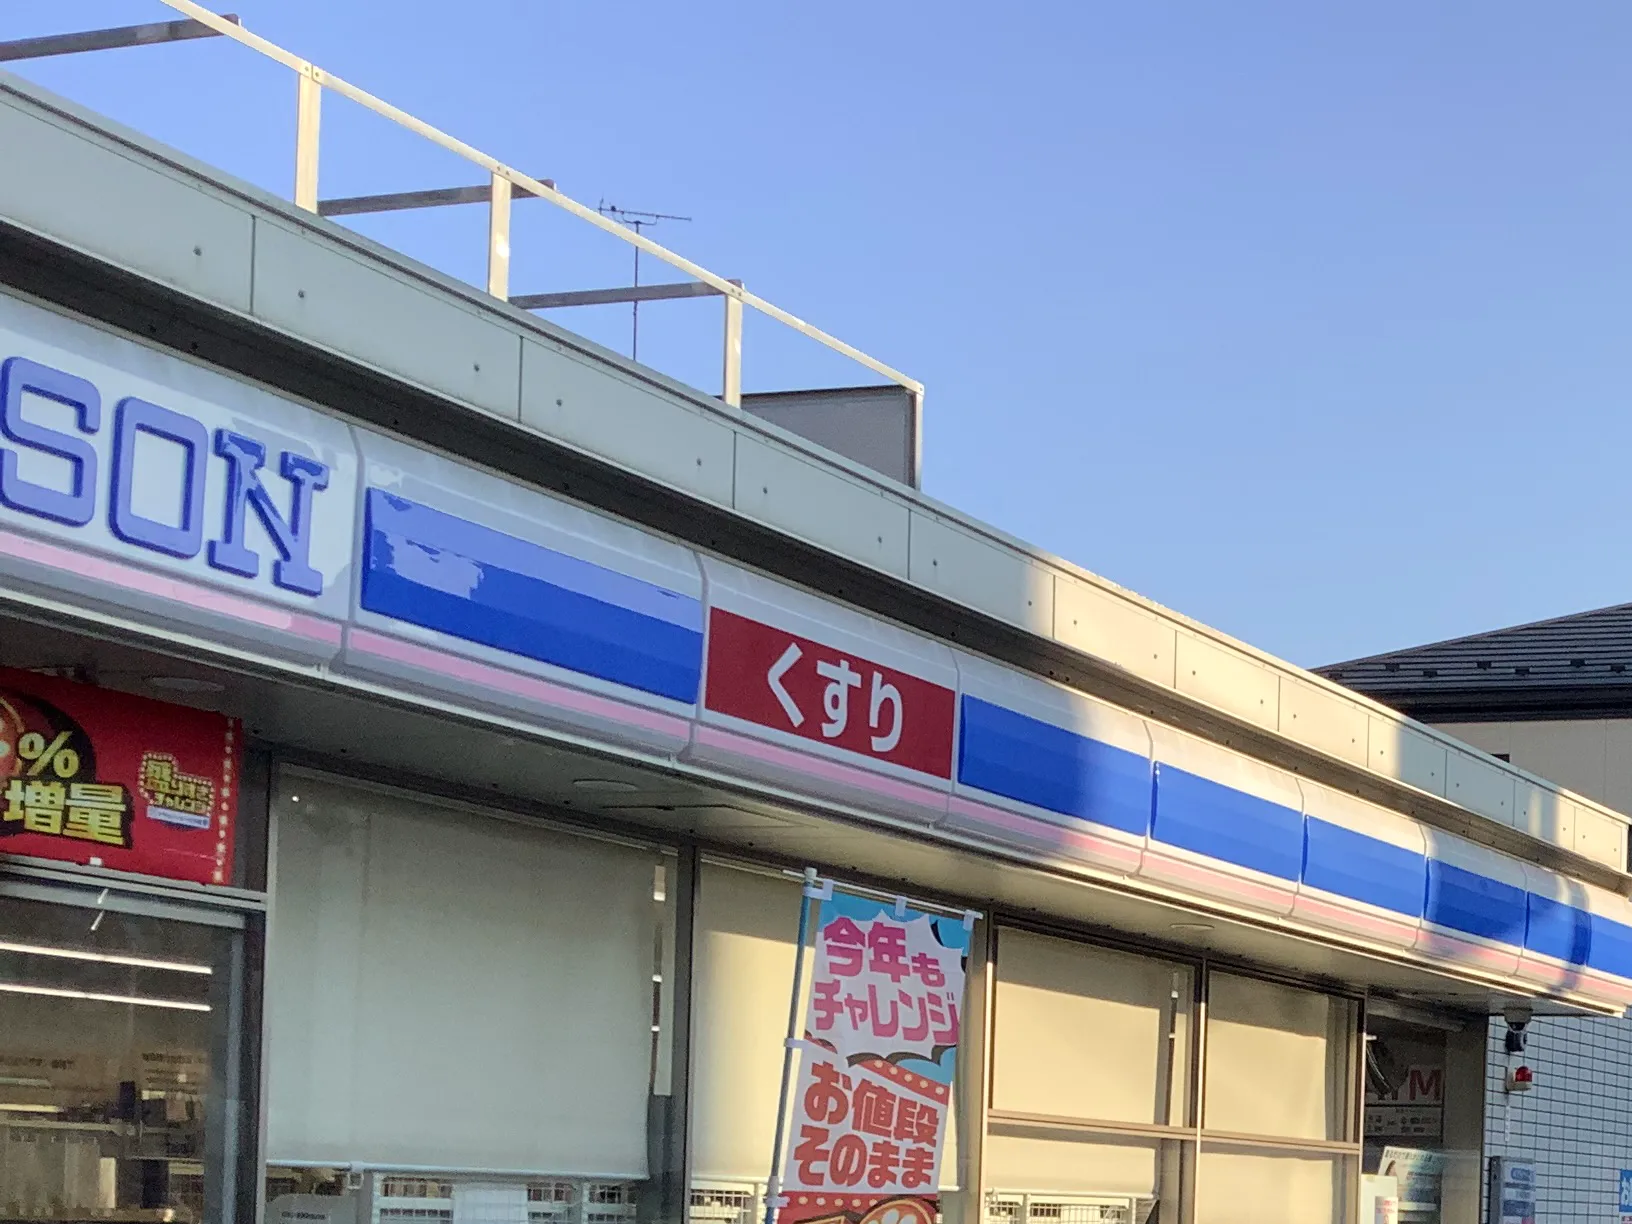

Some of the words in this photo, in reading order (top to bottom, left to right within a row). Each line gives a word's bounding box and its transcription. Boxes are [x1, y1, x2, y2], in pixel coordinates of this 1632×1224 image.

[0, 356, 329, 598] SON
[768, 642, 903, 752] くすり
[3, 780, 127, 846] 増量
[824, 917, 945, 987] 今年も
[813, 979, 960, 1044] チャレンジ
[804, 1061, 940, 1148] お値段
[793, 1124, 934, 1188] そのまま
